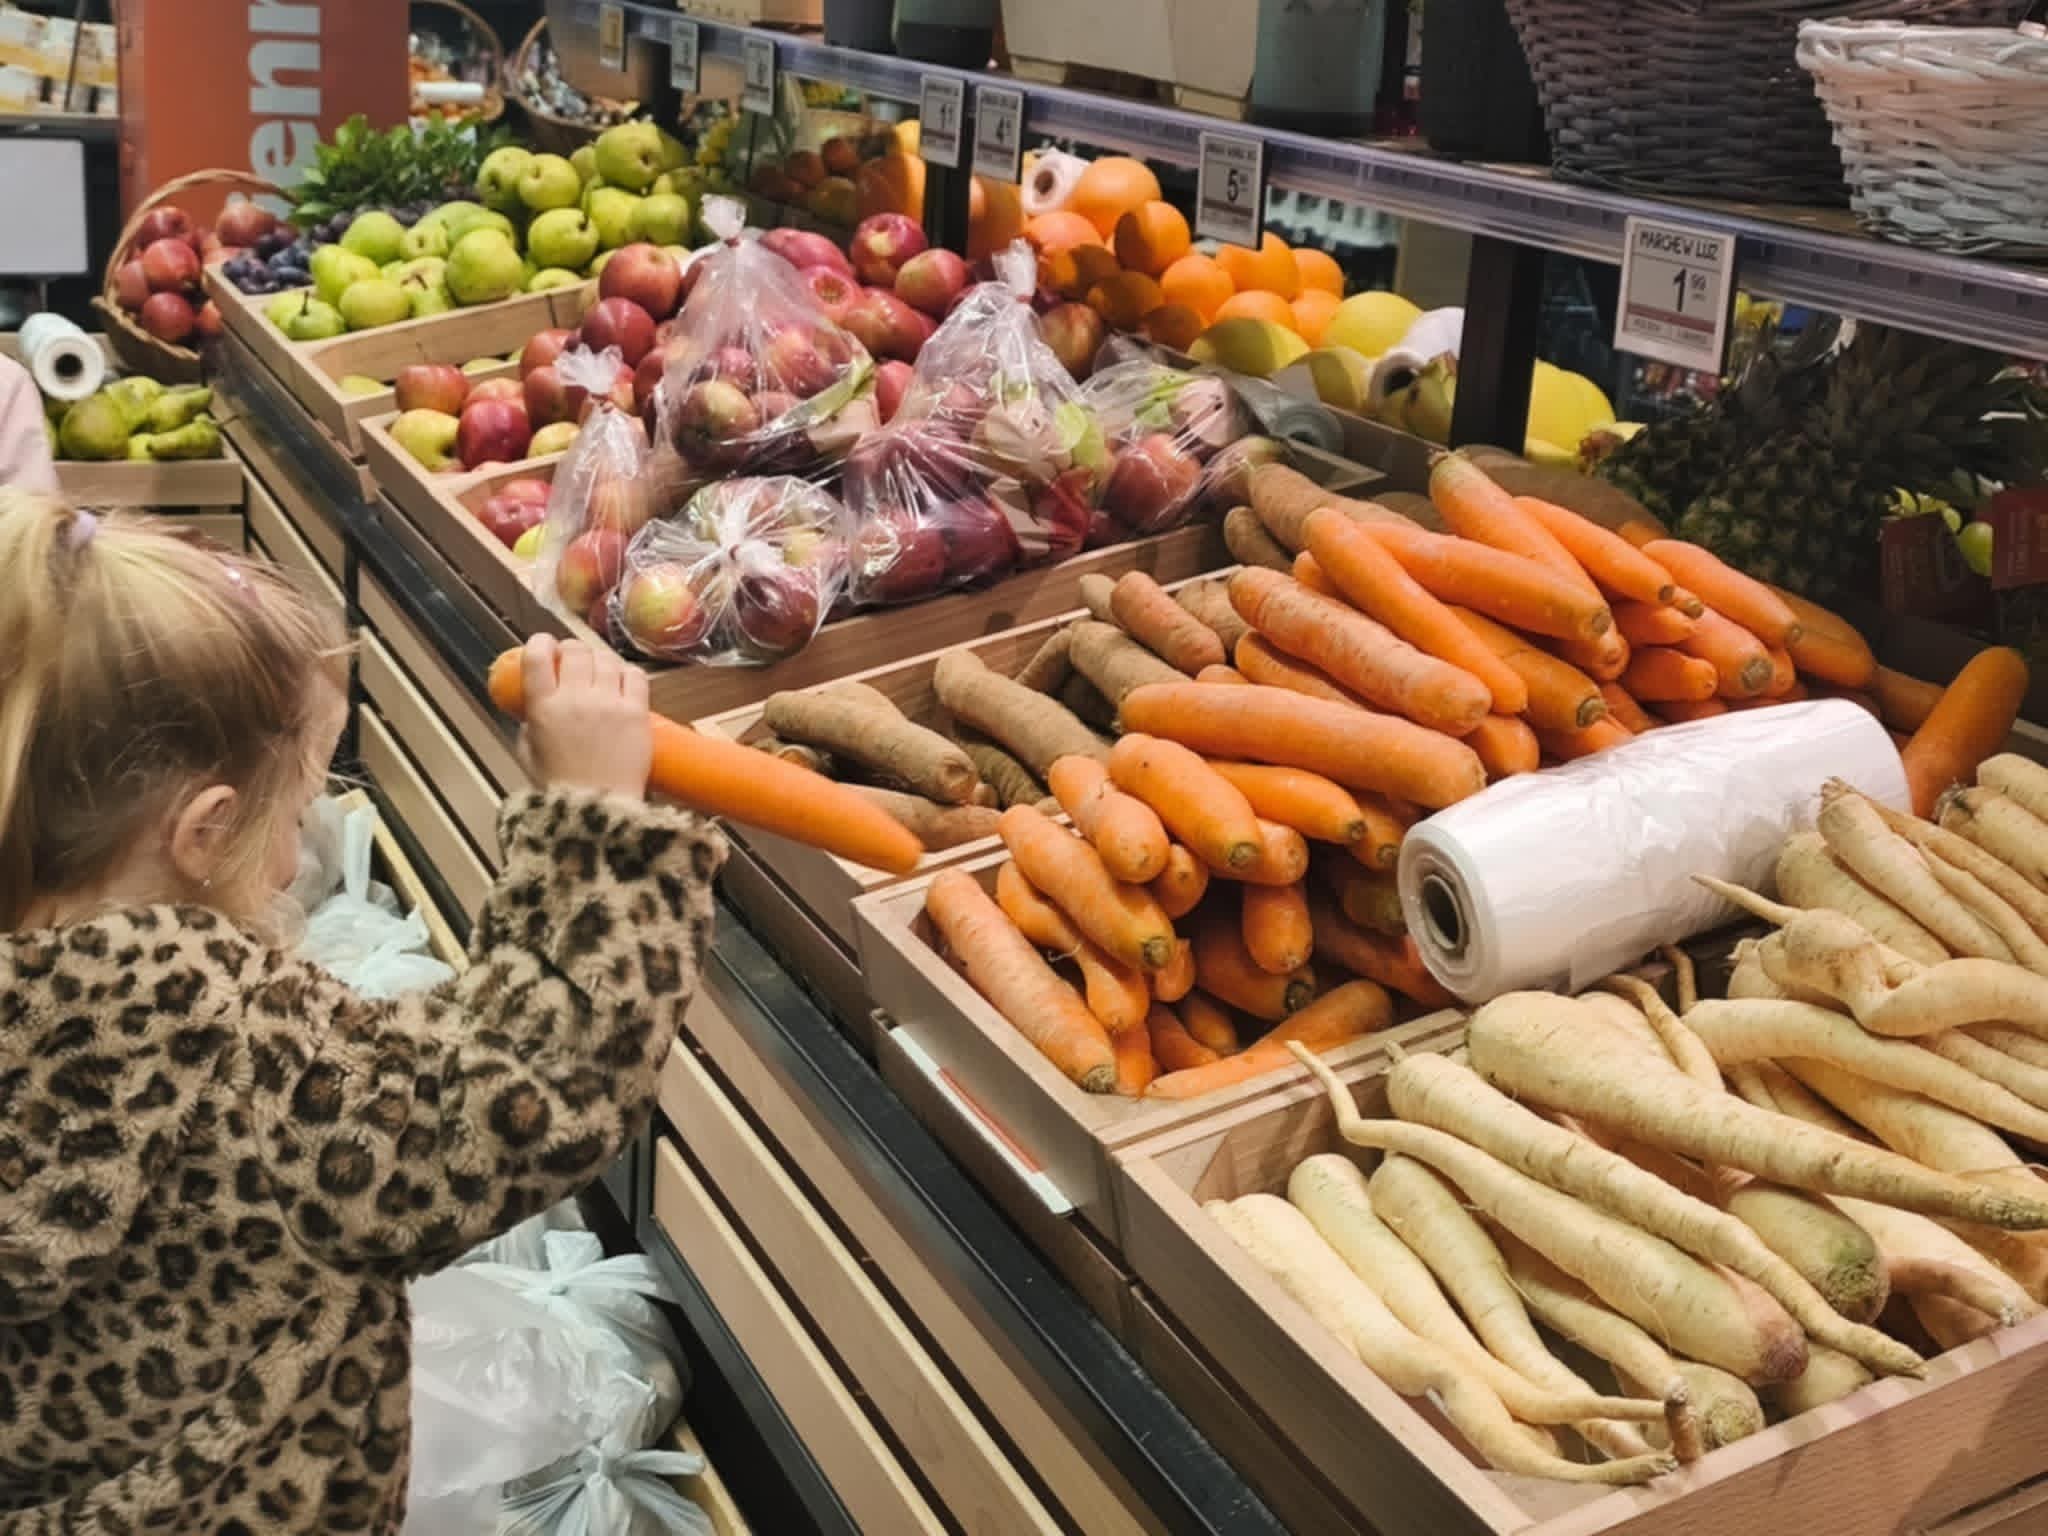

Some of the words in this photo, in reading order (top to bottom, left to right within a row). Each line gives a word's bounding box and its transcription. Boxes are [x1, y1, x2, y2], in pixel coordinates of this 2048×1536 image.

[1227, 168, 1239, 203] 5
[1696, 240, 1719, 260] LUZ
[1673, 268, 1687, 312] 1
